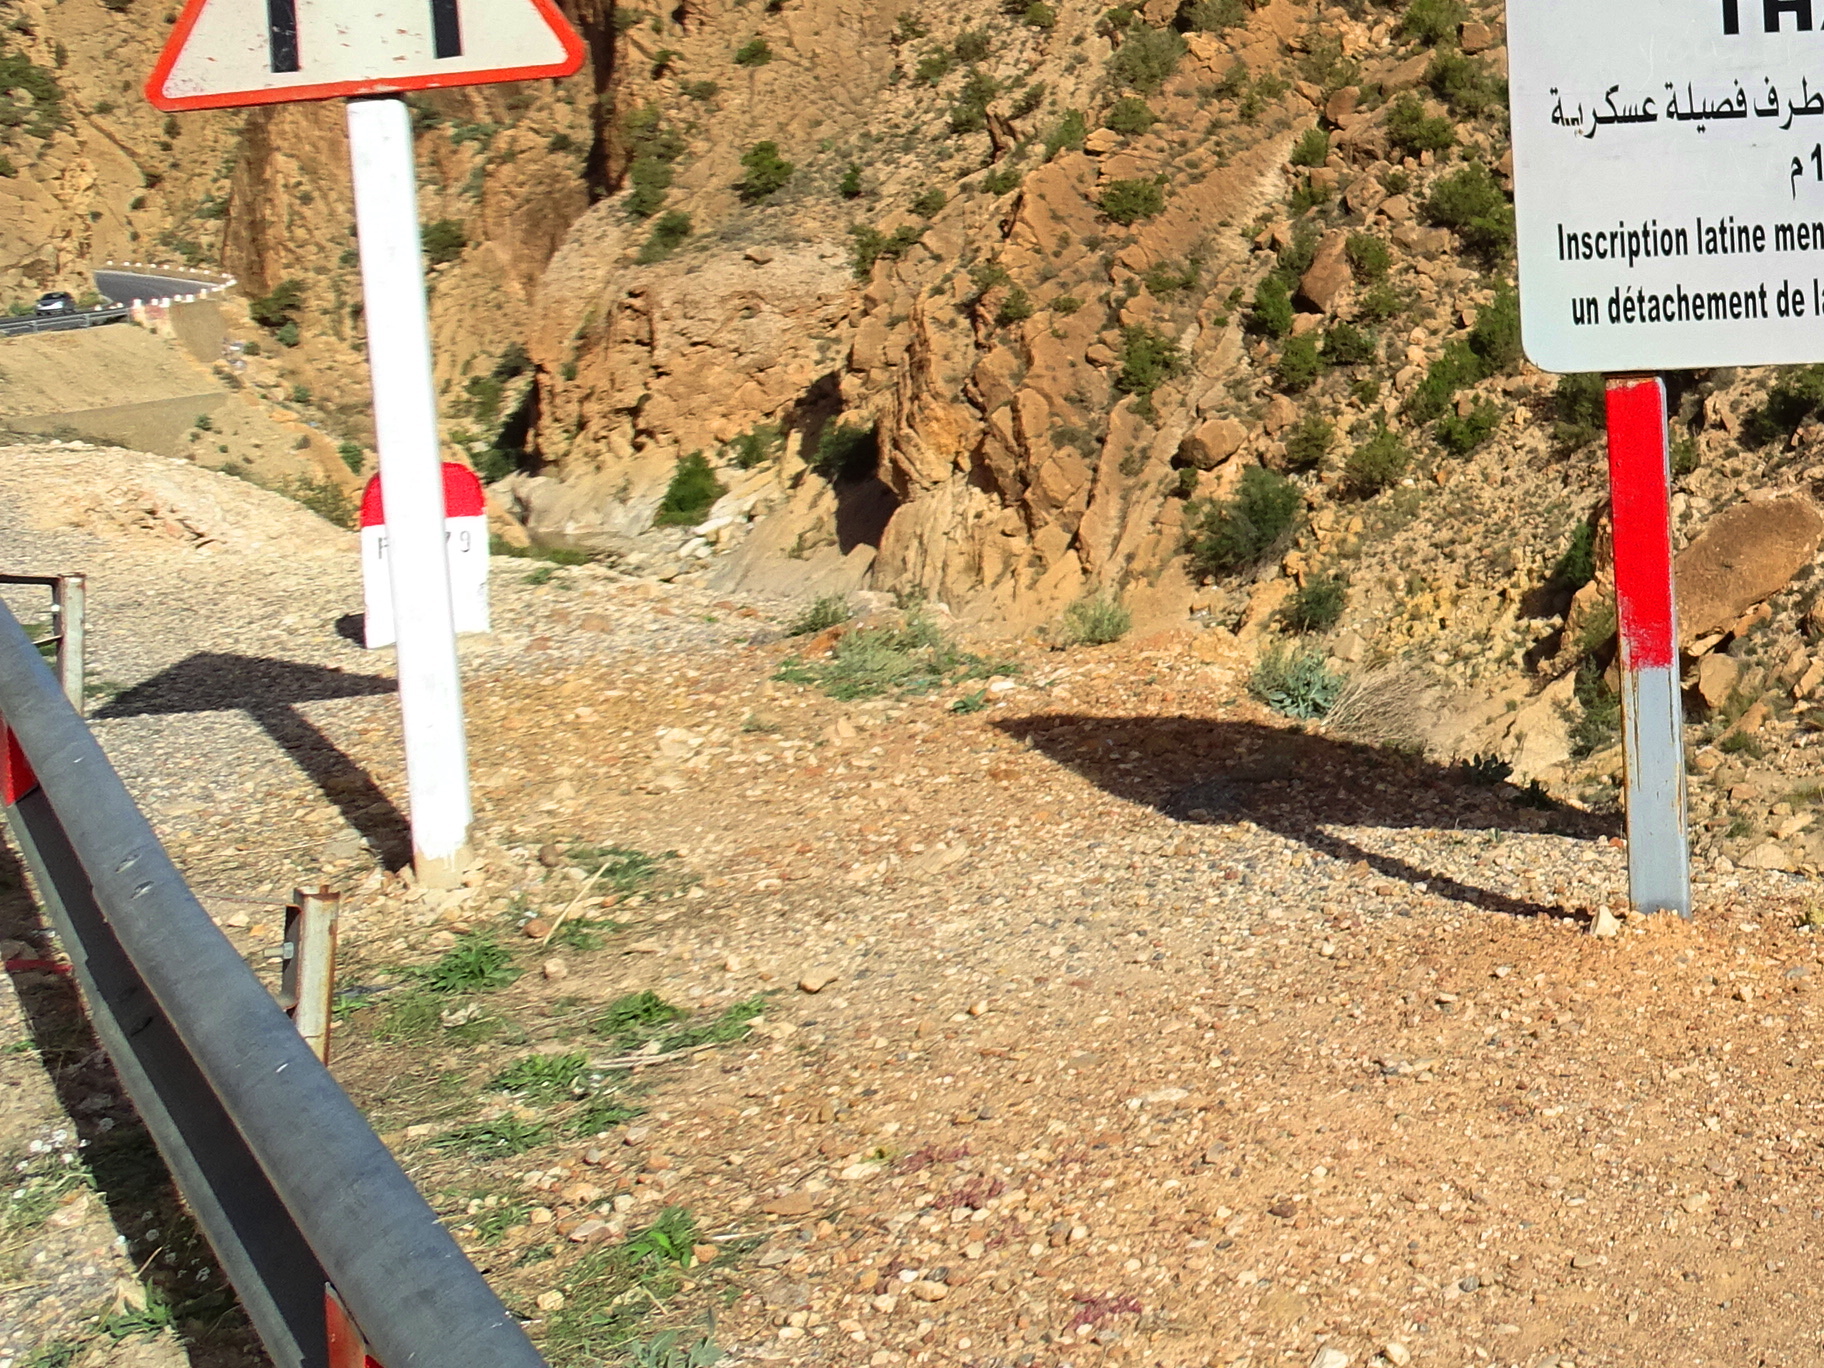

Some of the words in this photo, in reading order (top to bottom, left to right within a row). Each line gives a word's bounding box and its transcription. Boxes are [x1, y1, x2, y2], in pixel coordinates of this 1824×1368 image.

[1550, 85, 1658, 140] عسكرية
[1665, 78, 1748, 133] فصيلة
[1754, 76, 1824, 130] طرف
[1790, 156, 1804, 199] م
[1558, 220, 1689, 268] Inscription
[1696, 215, 1766, 255] latine
[1572, 296, 1599, 326] un
[1607, 282, 1769, 325] détachement
[1776, 279, 1805, 318] de
